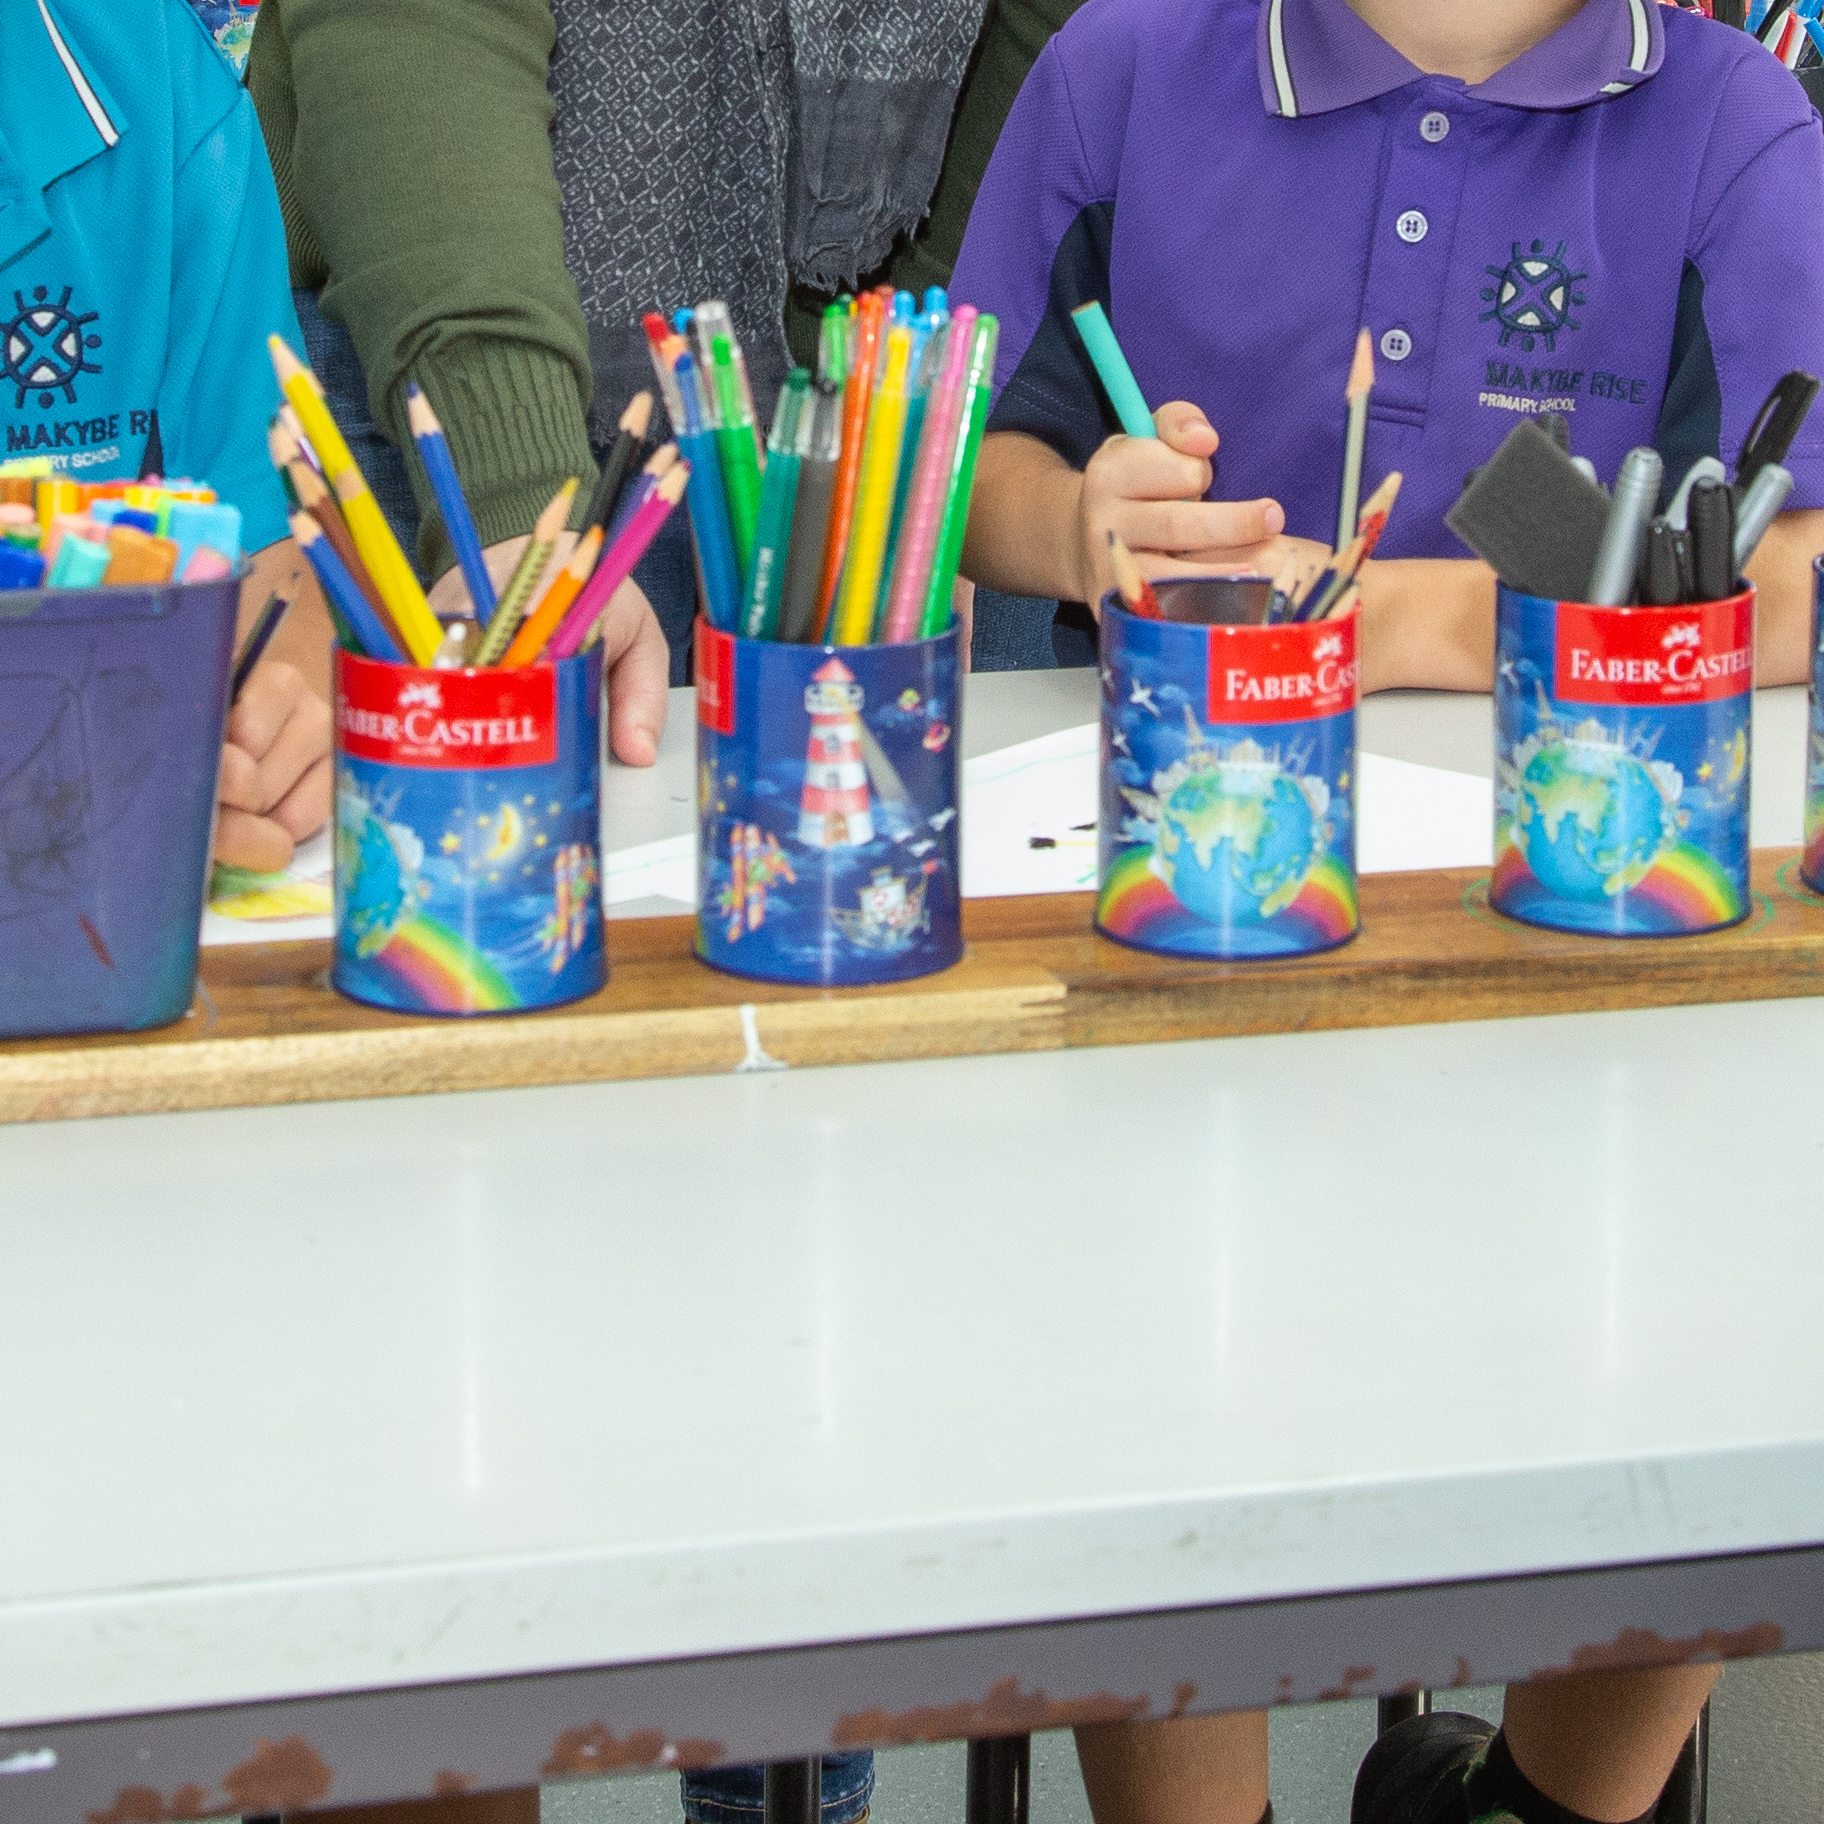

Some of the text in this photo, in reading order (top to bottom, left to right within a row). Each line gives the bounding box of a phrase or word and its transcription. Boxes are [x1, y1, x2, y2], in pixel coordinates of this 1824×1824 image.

[1483, 360, 1647, 405] MAKYBE RISE
[1479, 392, 1538, 414] PRIMARY
[6, 414, 121, 453] MAKYBE
[71, 445, 120, 469] SCHOOL
